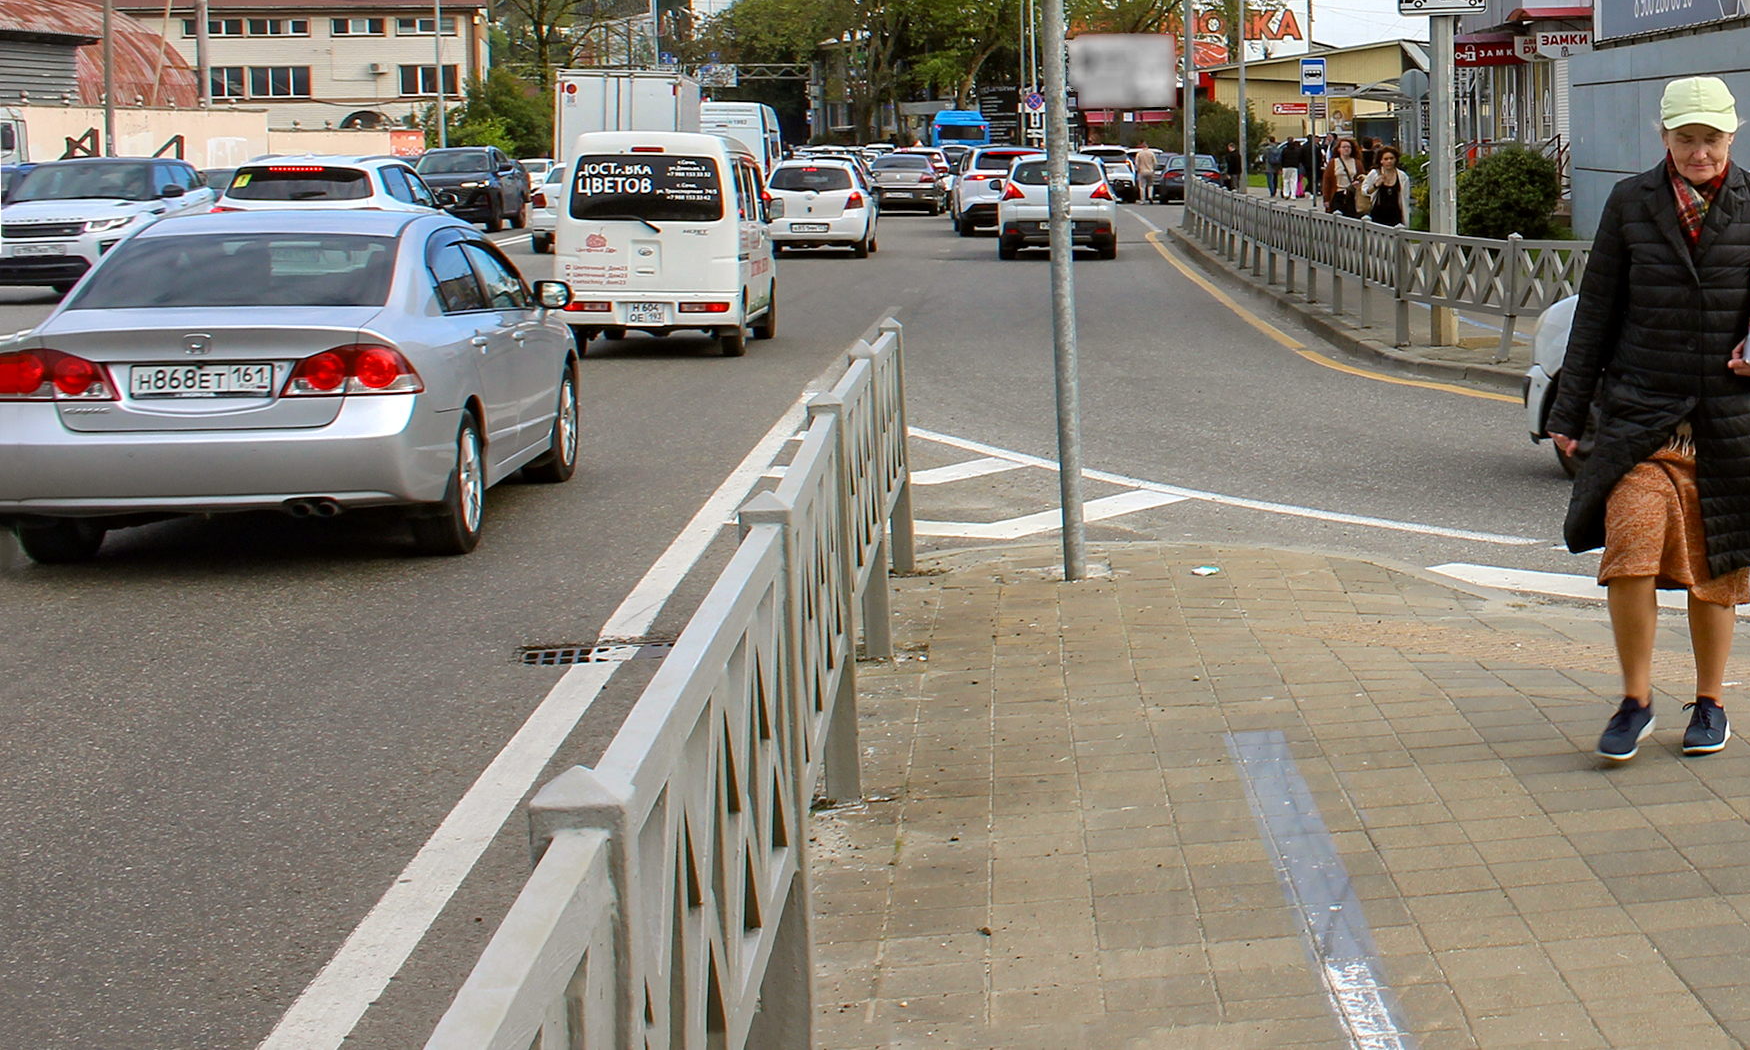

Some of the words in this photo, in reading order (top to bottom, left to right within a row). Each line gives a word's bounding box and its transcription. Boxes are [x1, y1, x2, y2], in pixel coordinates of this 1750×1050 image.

[1541, 34, 1588, 46] ЗАМКИ
[577, 176, 653, 197] ЦВЕТОВ
[138, 368, 226, 390] Н868ЕТ
[231, 367, 265, 383] 161
